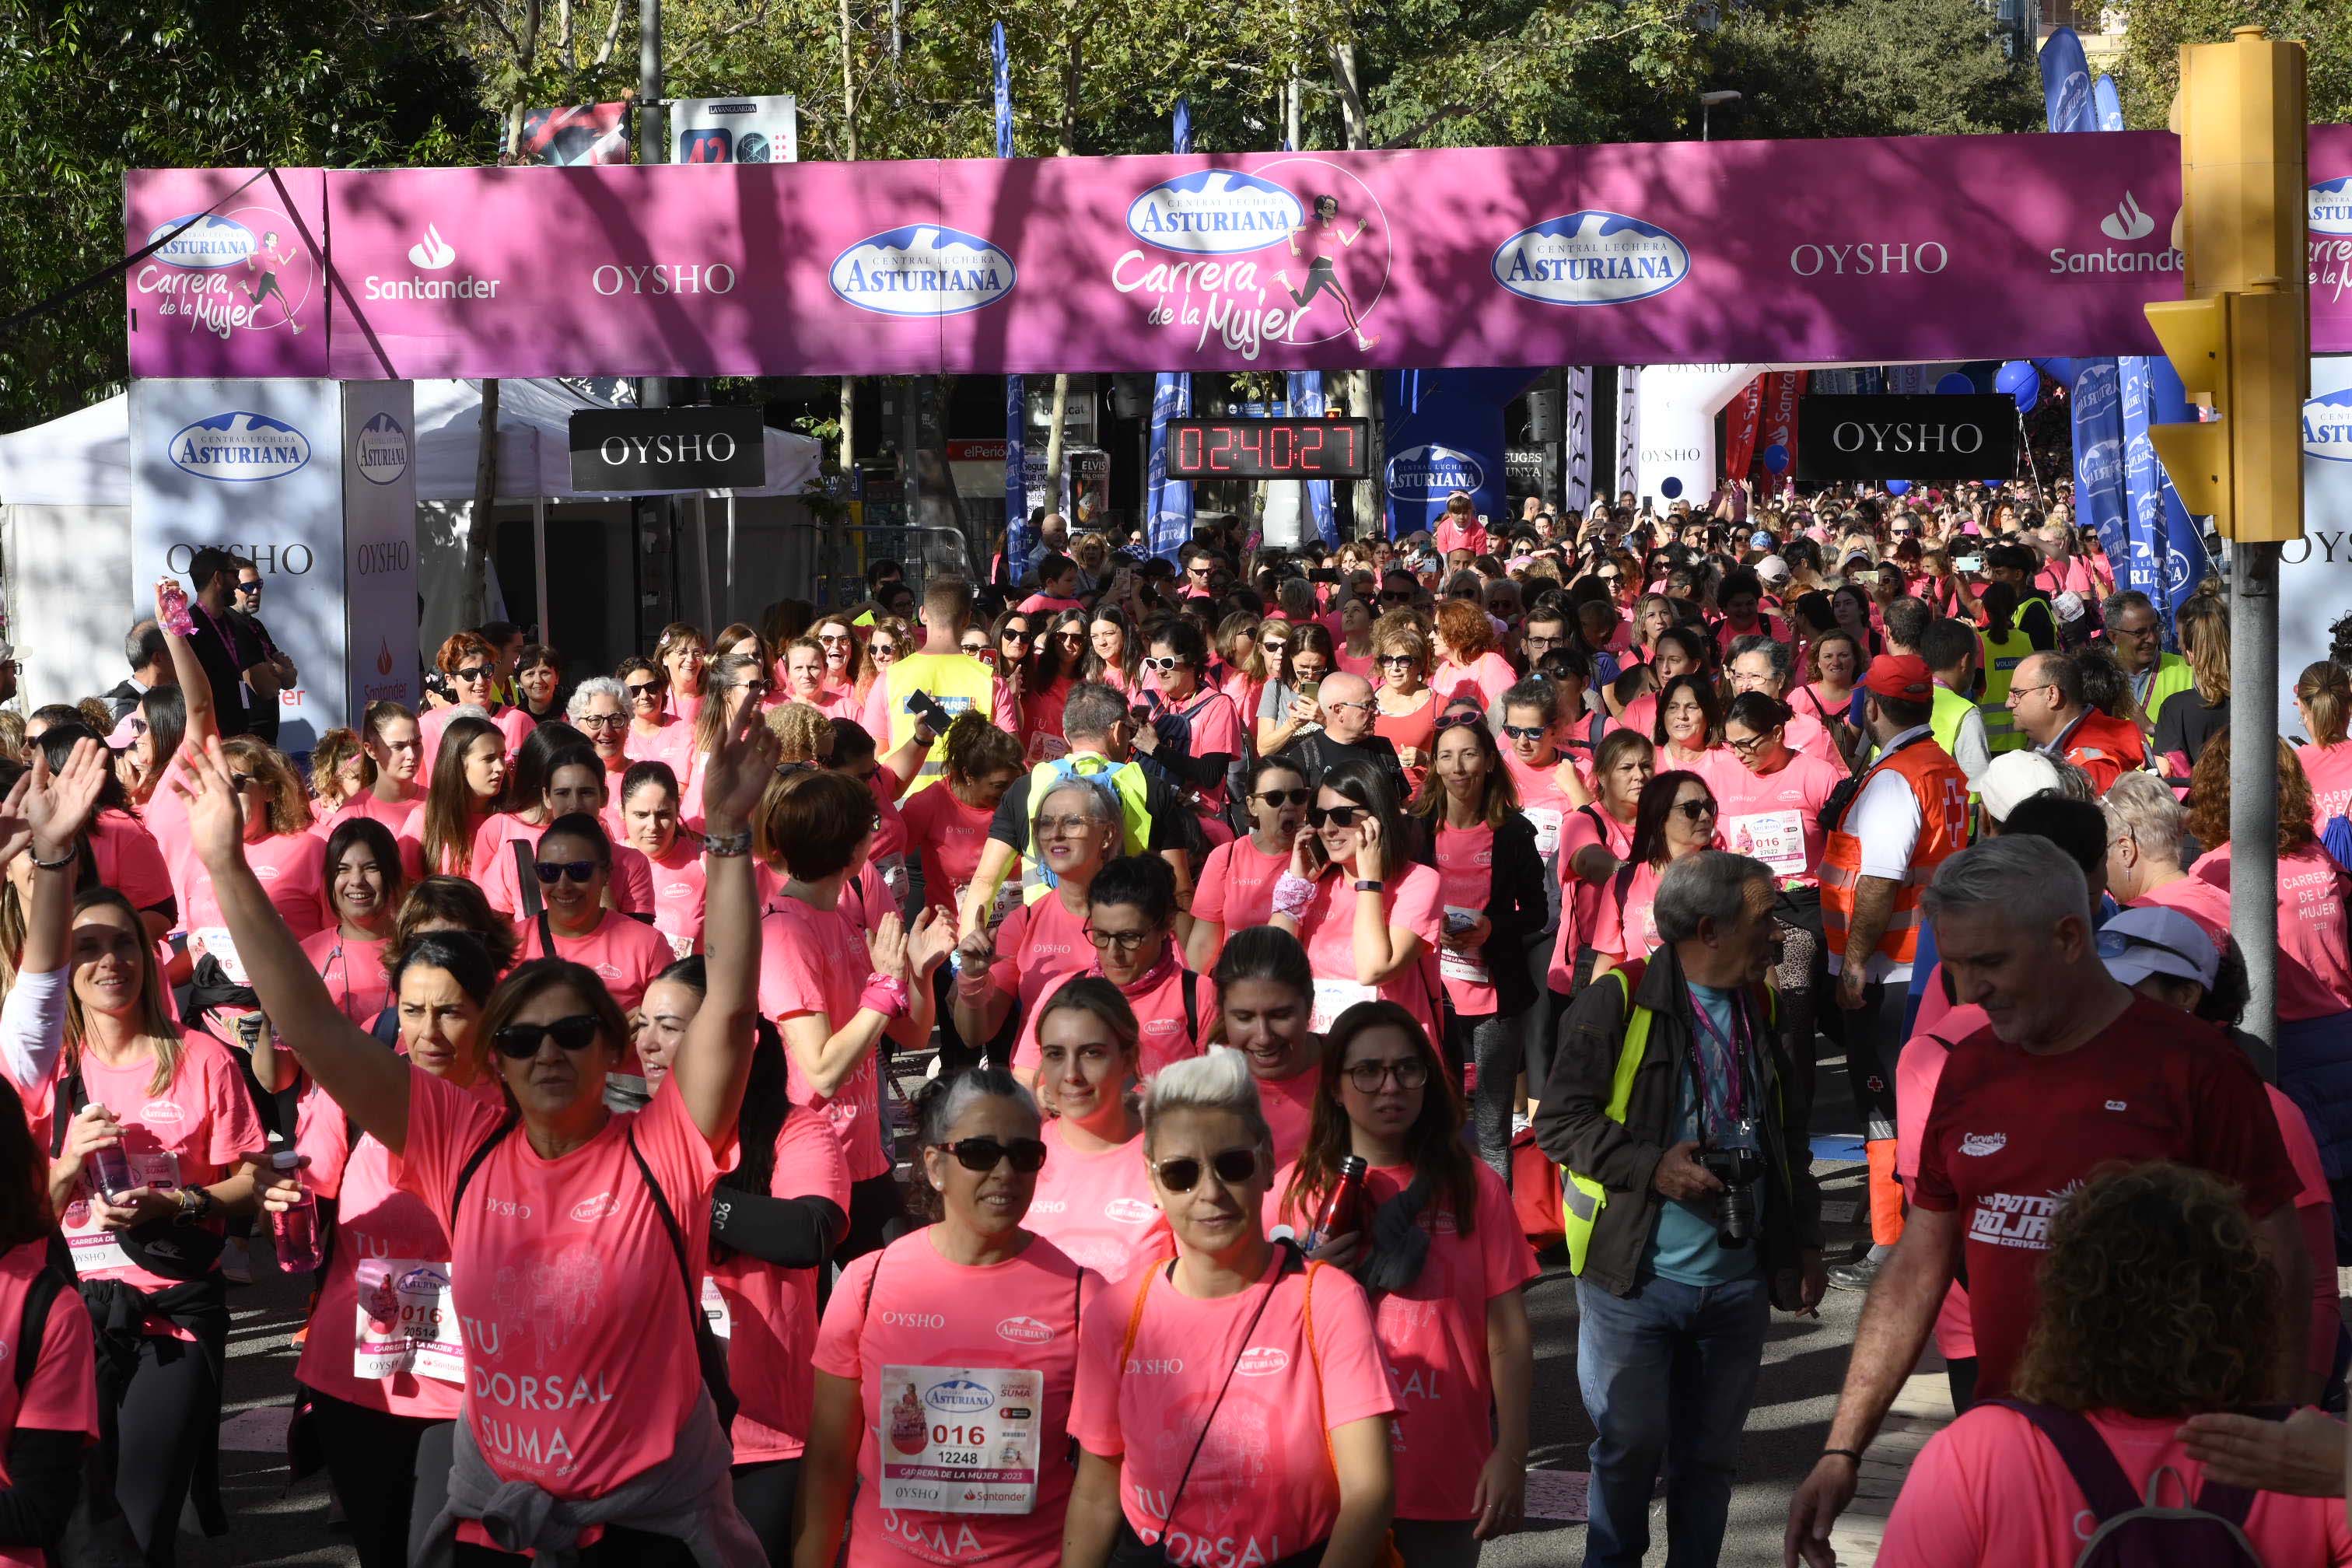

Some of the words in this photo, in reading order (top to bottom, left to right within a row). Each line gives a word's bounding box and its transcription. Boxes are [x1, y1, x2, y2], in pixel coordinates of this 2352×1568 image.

[1167, 198, 1223, 208] CENTRAL
[2315, 196, 2352, 205] CENTRA
[1140, 201, 1289, 233] ASTURIANA
[1538, 244, 1587, 253] CENTRAL
[1605, 242, 1668, 251] LECHERA
[1790, 242, 1948, 275] OYSHO
[872, 255, 931, 265] CENTRAL
[938, 254, 996, 265] LECHERA
[1507, 247, 1674, 282] ASTURIANA
[2049, 247, 2184, 274] Santande
[137, 264, 228, 294] Carrera
[592, 263, 736, 296] OYSHO
[844, 257, 1002, 292] ASTURIANA
[1111, 249, 1258, 293] Carrera
[365, 275, 500, 300] Santander
[159, 295, 177, 315] de
[180, 295, 192, 315] la
[191, 291, 263, 340] Mujer
[1147, 295, 1174, 326] de
[1181, 293, 1200, 326] la
[1195, 287, 1312, 361] Mujer
[201, 435, 247, 443] CENTRAL
[250, 434, 296, 443] LECHERA
[1832, 422, 1983, 453] OYSHO
[178, 436, 301, 465] ASTURIANA
[360, 440, 404, 467] ASTURIANA
[600, 432, 736, 466] OYSHO
[964, 444, 1007, 457] elPerió
[1180, 427, 1353, 471] 02:40:27
[1641, 447, 1701, 462] OYSHO
[1388, 467, 1476, 490] ASTURIANA
[358, 540, 409, 576] OYSHO
[1755, 837, 1780, 848] 016
[992, 901, 1005, 912] 16
[2298, 889, 2315, 904] DE
[2298, 901, 2336, 920] MUJER
[71, 1236, 103, 1245] CARRERA
[353, 1230, 388, 1259] TU
[401, 1305, 443, 1324] 016
[883, 1311, 945, 1329] OYSHO
[404, 1326, 436, 1339] 20514
[461, 1314, 499, 1355] TU
[427, 1343, 453, 1353] MUJER
[369, 1360, 400, 1370] OYSH
[473, 1365, 614, 1411] DORSAL
[931, 1391, 989, 1405] ASTURIANA
[1000, 1389, 1031, 1398] SUMA
[481, 1414, 573, 1465] SUMA
[933, 1424, 985, 1445] 016
[938, 1451, 978, 1465] 12248
[901, 1467, 940, 1478] CARRERA
[968, 1471, 999, 1480] MUJER
[895, 1486, 939, 1500] OYSHO
[977, 1490, 1027, 1502] Santander
[1134, 1484, 1168, 1520] TU
[884, 1508, 982, 1557] SUMA
